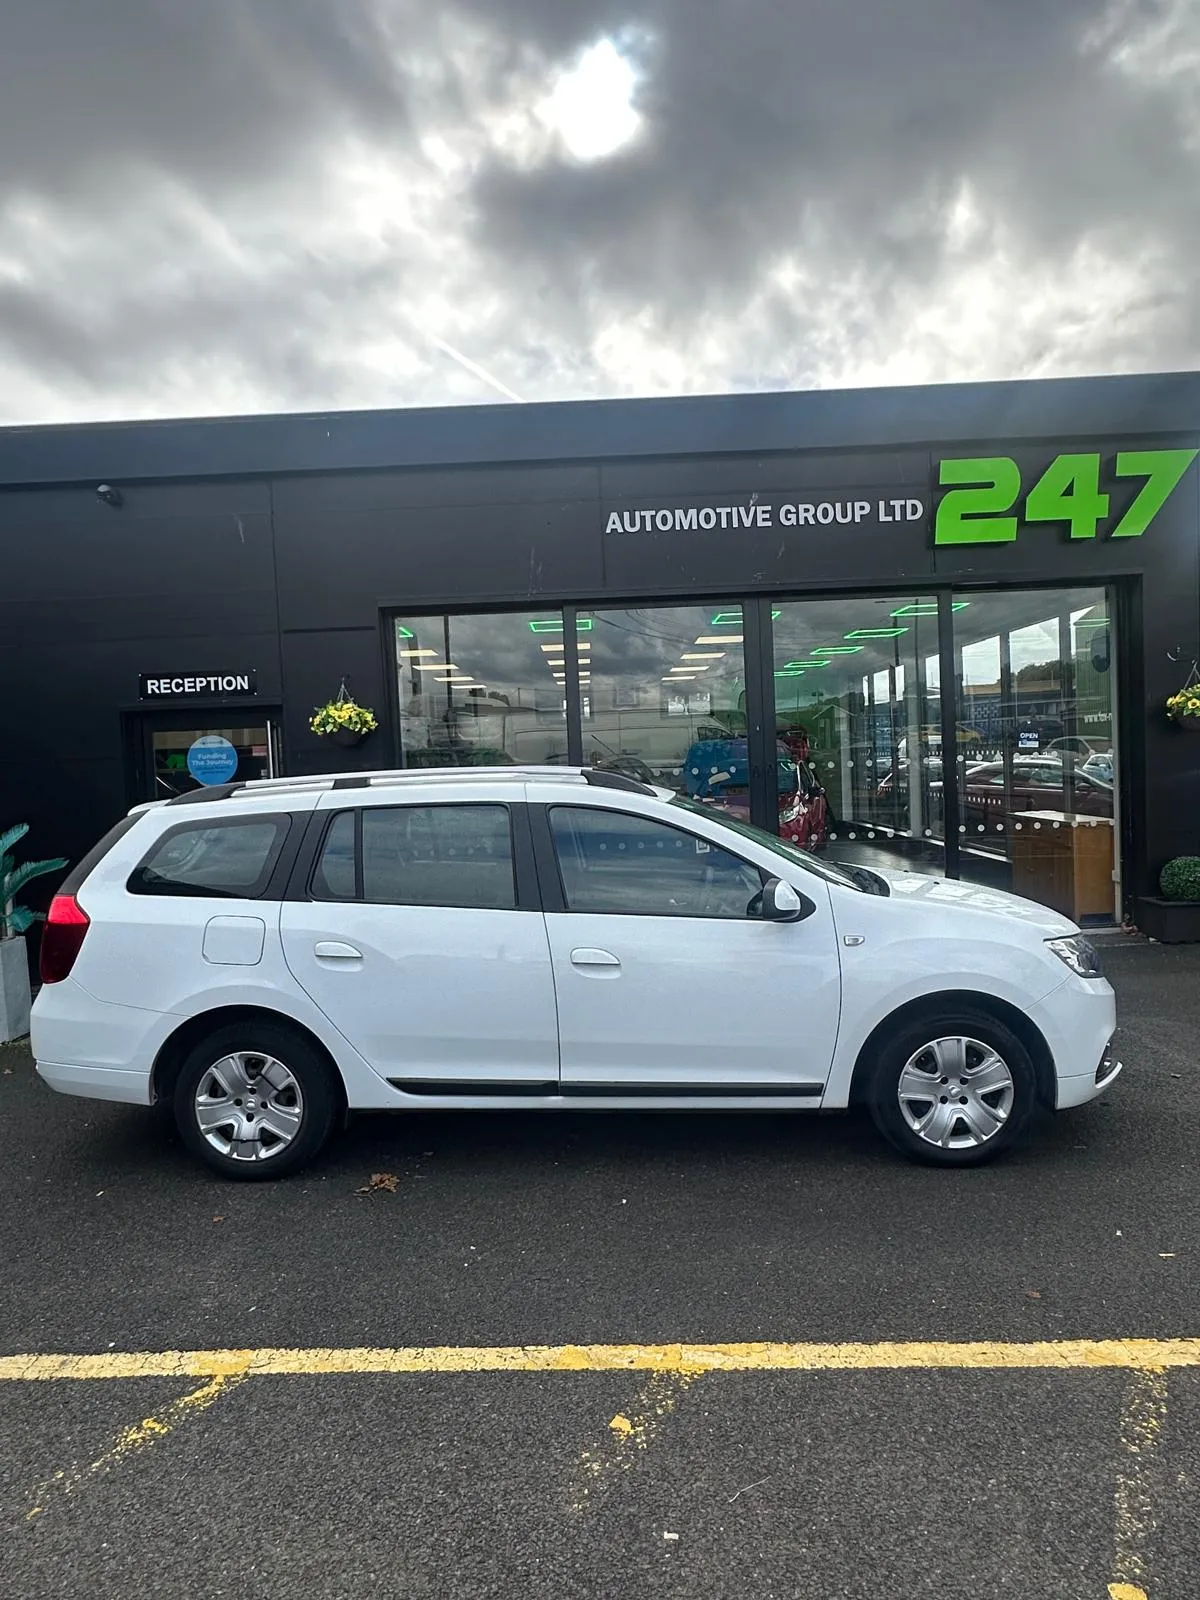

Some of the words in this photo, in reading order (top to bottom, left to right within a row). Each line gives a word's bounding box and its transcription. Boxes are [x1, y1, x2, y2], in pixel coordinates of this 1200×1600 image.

[935, 448, 1200, 545] 247
[605, 505, 773, 534] AUTOMOTIVE
[779, 501, 871, 526] GROUP
[878, 499, 924, 522] LTD
[146, 675, 249, 694] RECEPTION
[206, 759, 234, 767] Journey
